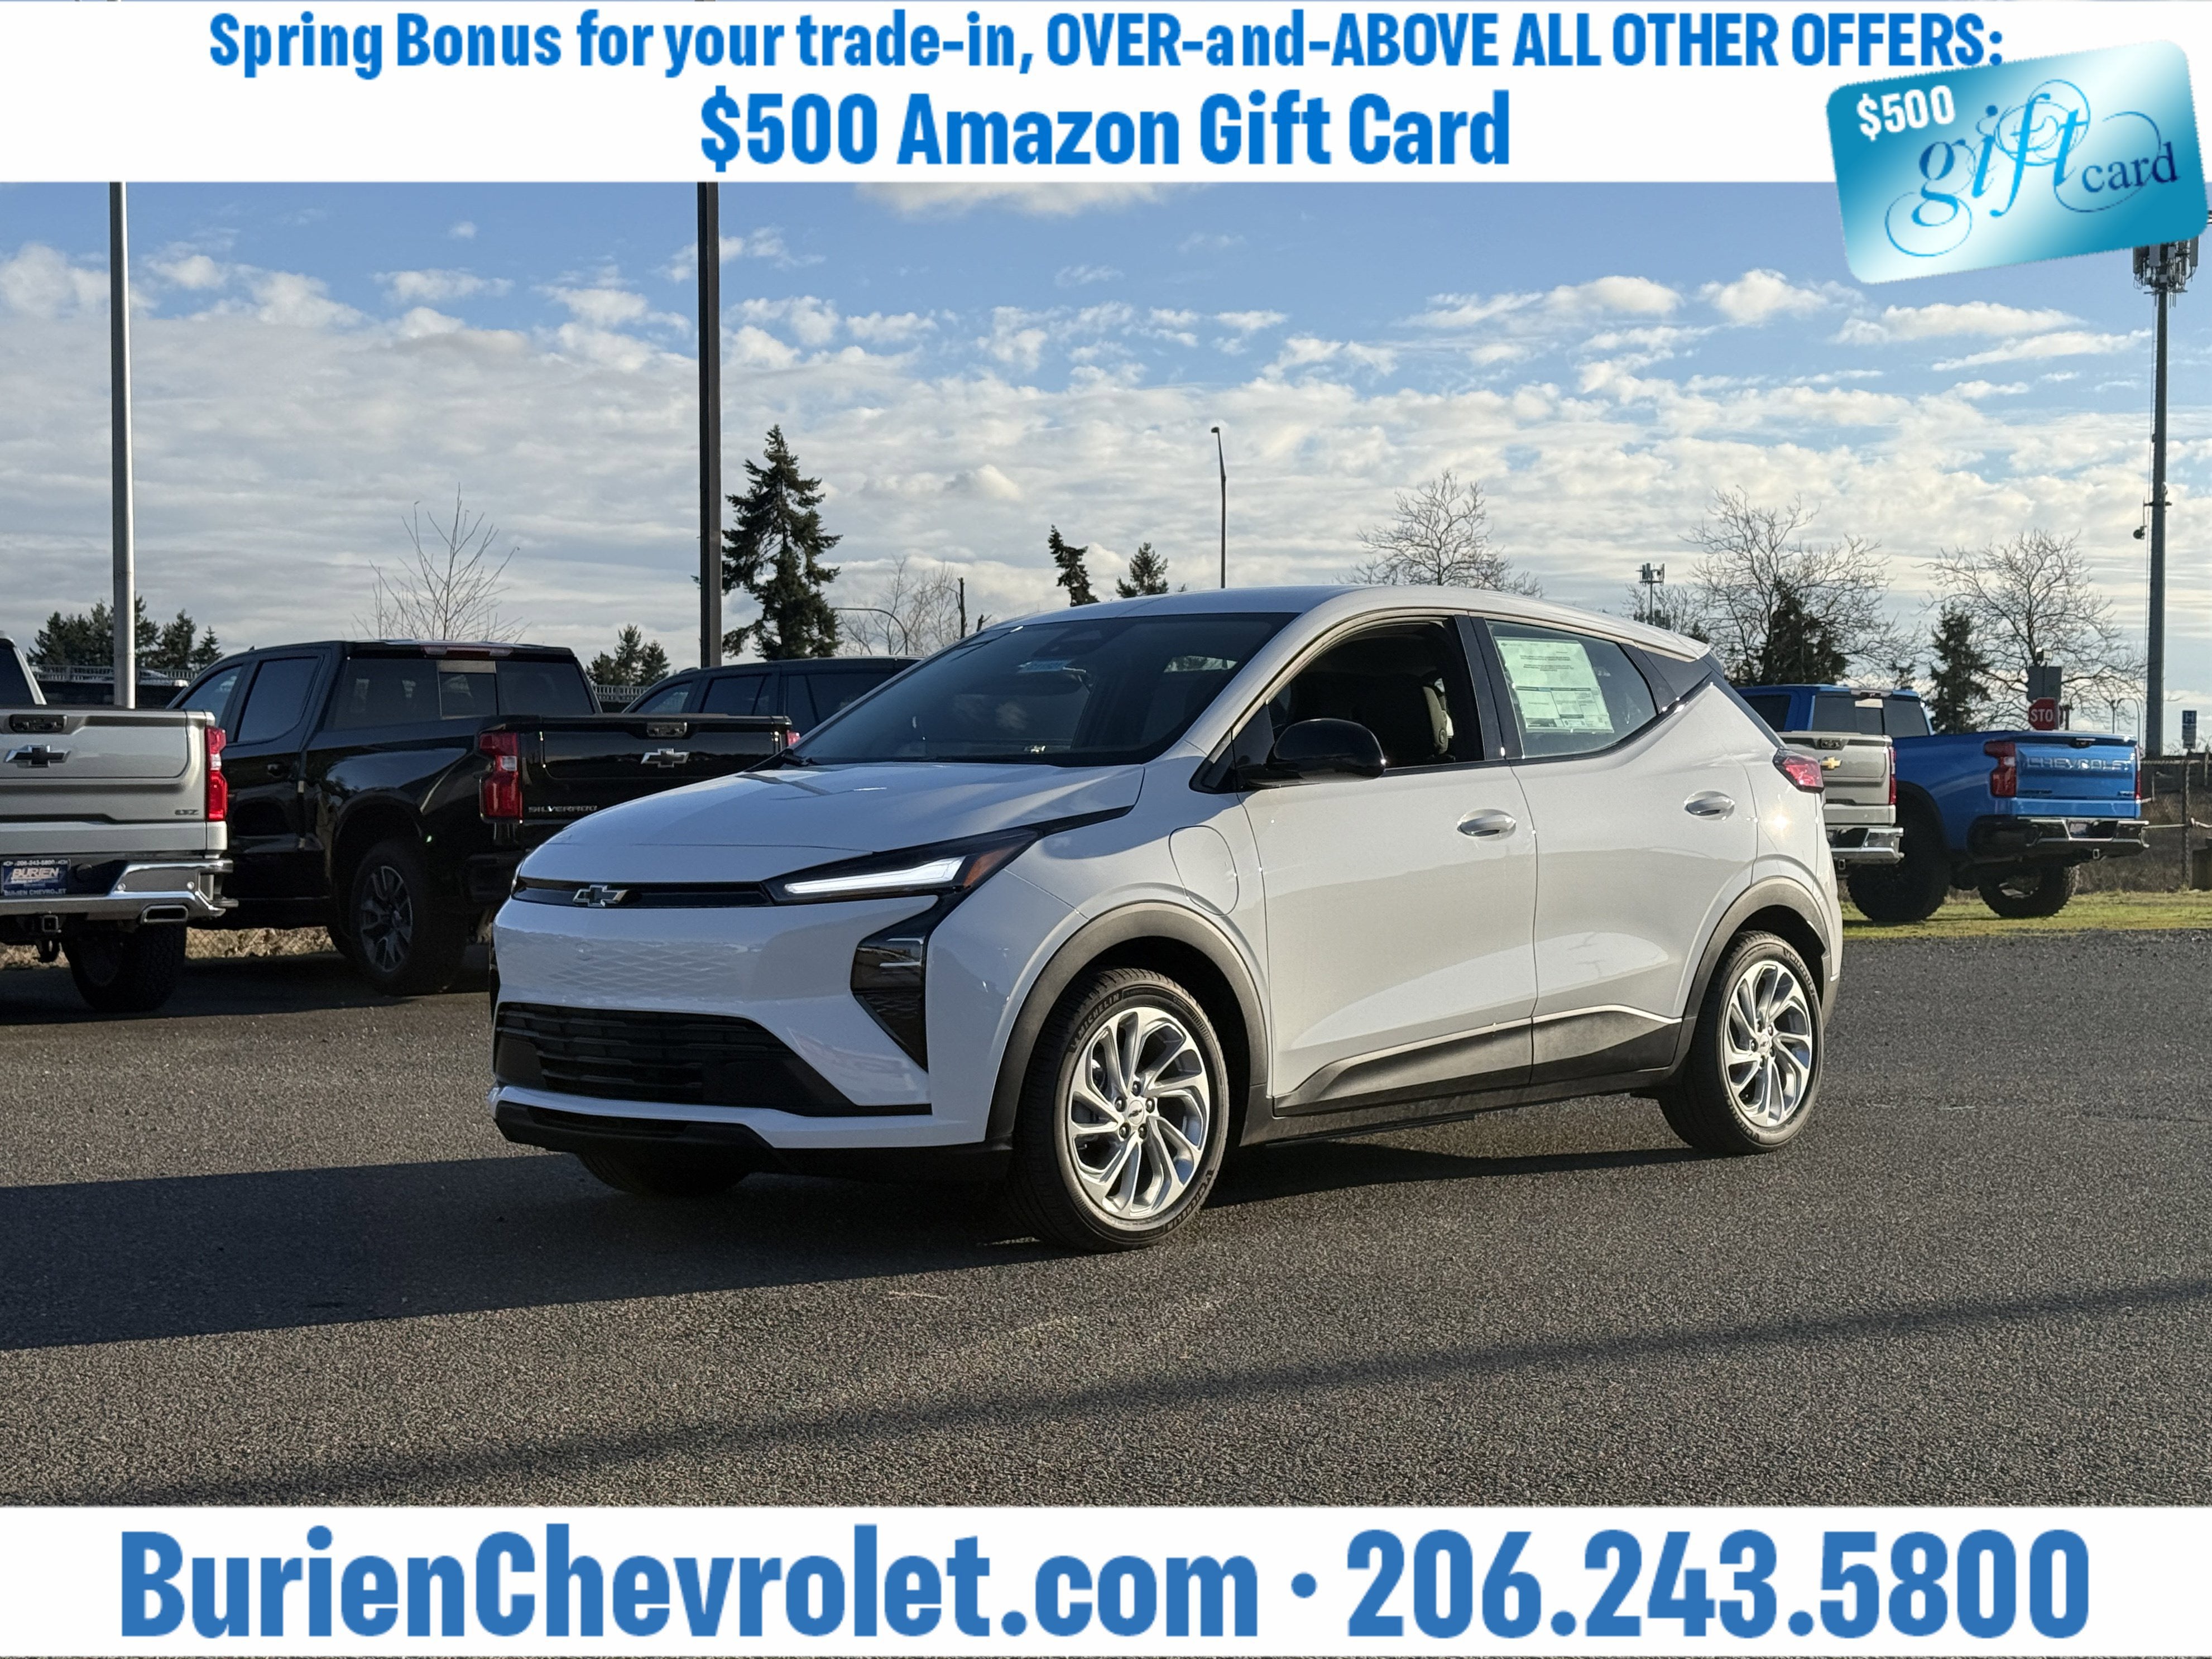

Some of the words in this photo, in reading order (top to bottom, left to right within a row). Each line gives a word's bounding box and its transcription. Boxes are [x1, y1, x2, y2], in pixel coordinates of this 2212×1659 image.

[2031, 708, 2053, 722] STO
[2027, 757, 2132, 771] CHEVROLET
[12, 867, 59, 879] BURIEN
[1078, 992, 1120, 1037] MICHELIN
